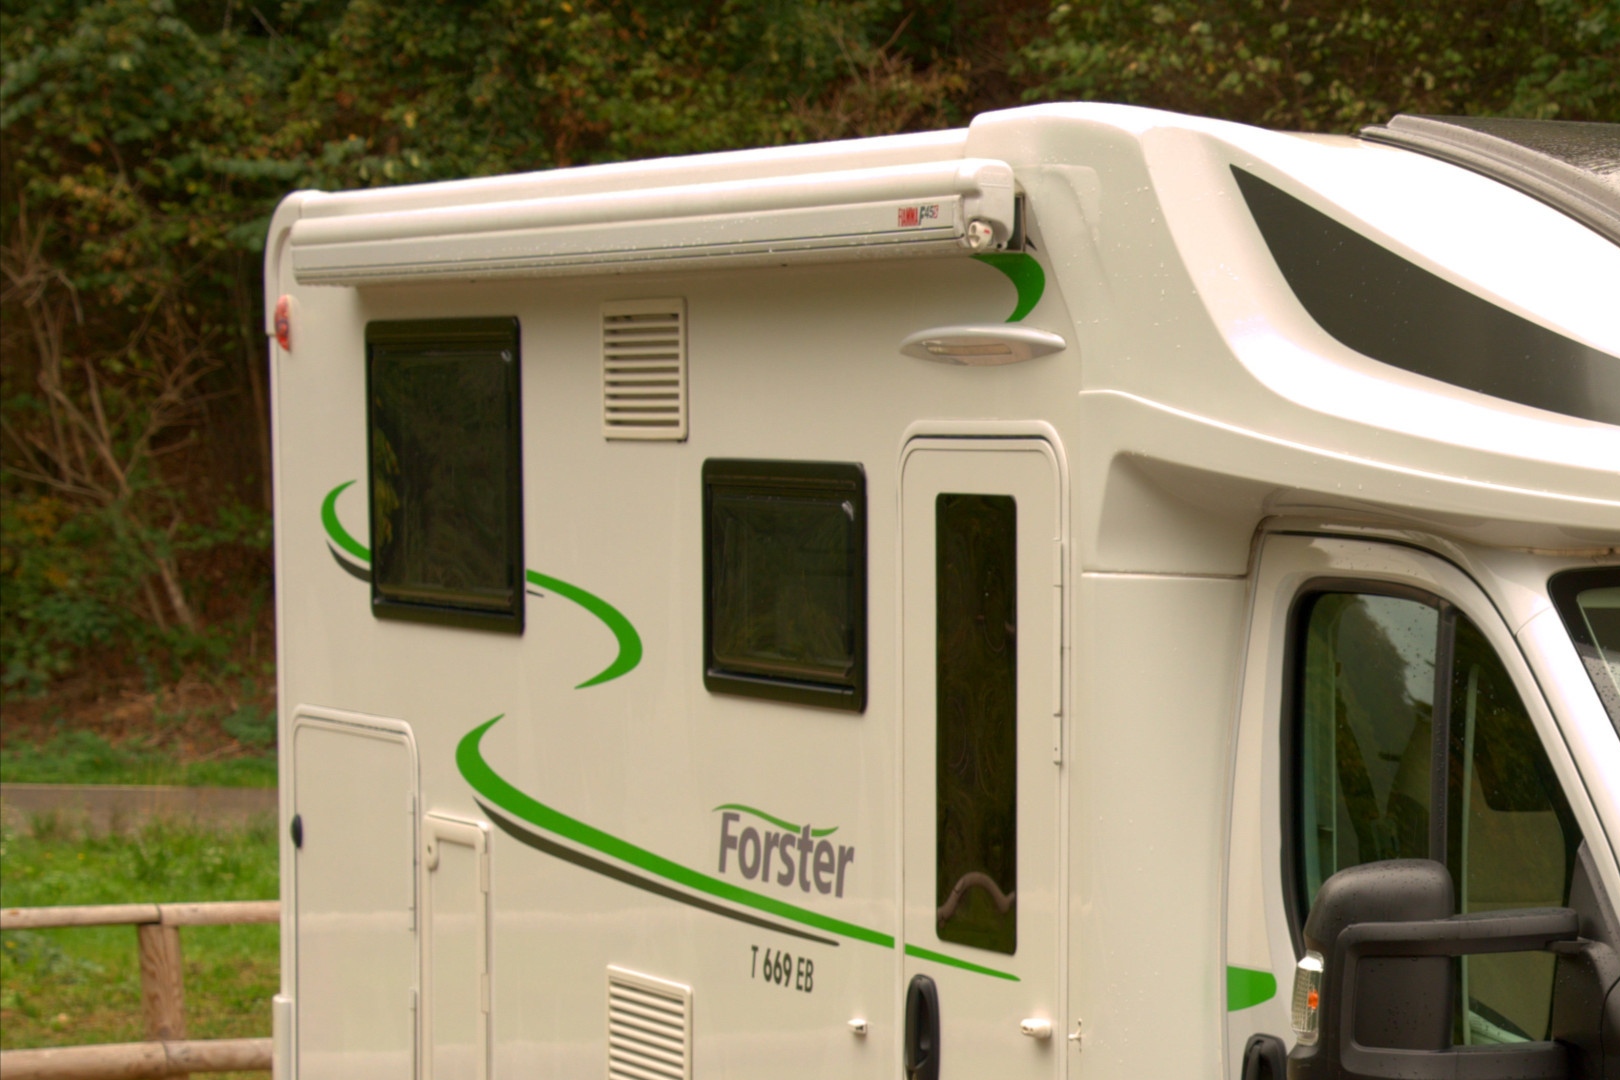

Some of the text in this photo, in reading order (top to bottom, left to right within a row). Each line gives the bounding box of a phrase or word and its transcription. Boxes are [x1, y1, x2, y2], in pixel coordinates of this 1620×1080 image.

[718, 811, 855, 899] Forster
[751, 944, 814, 993] T 669 EB
